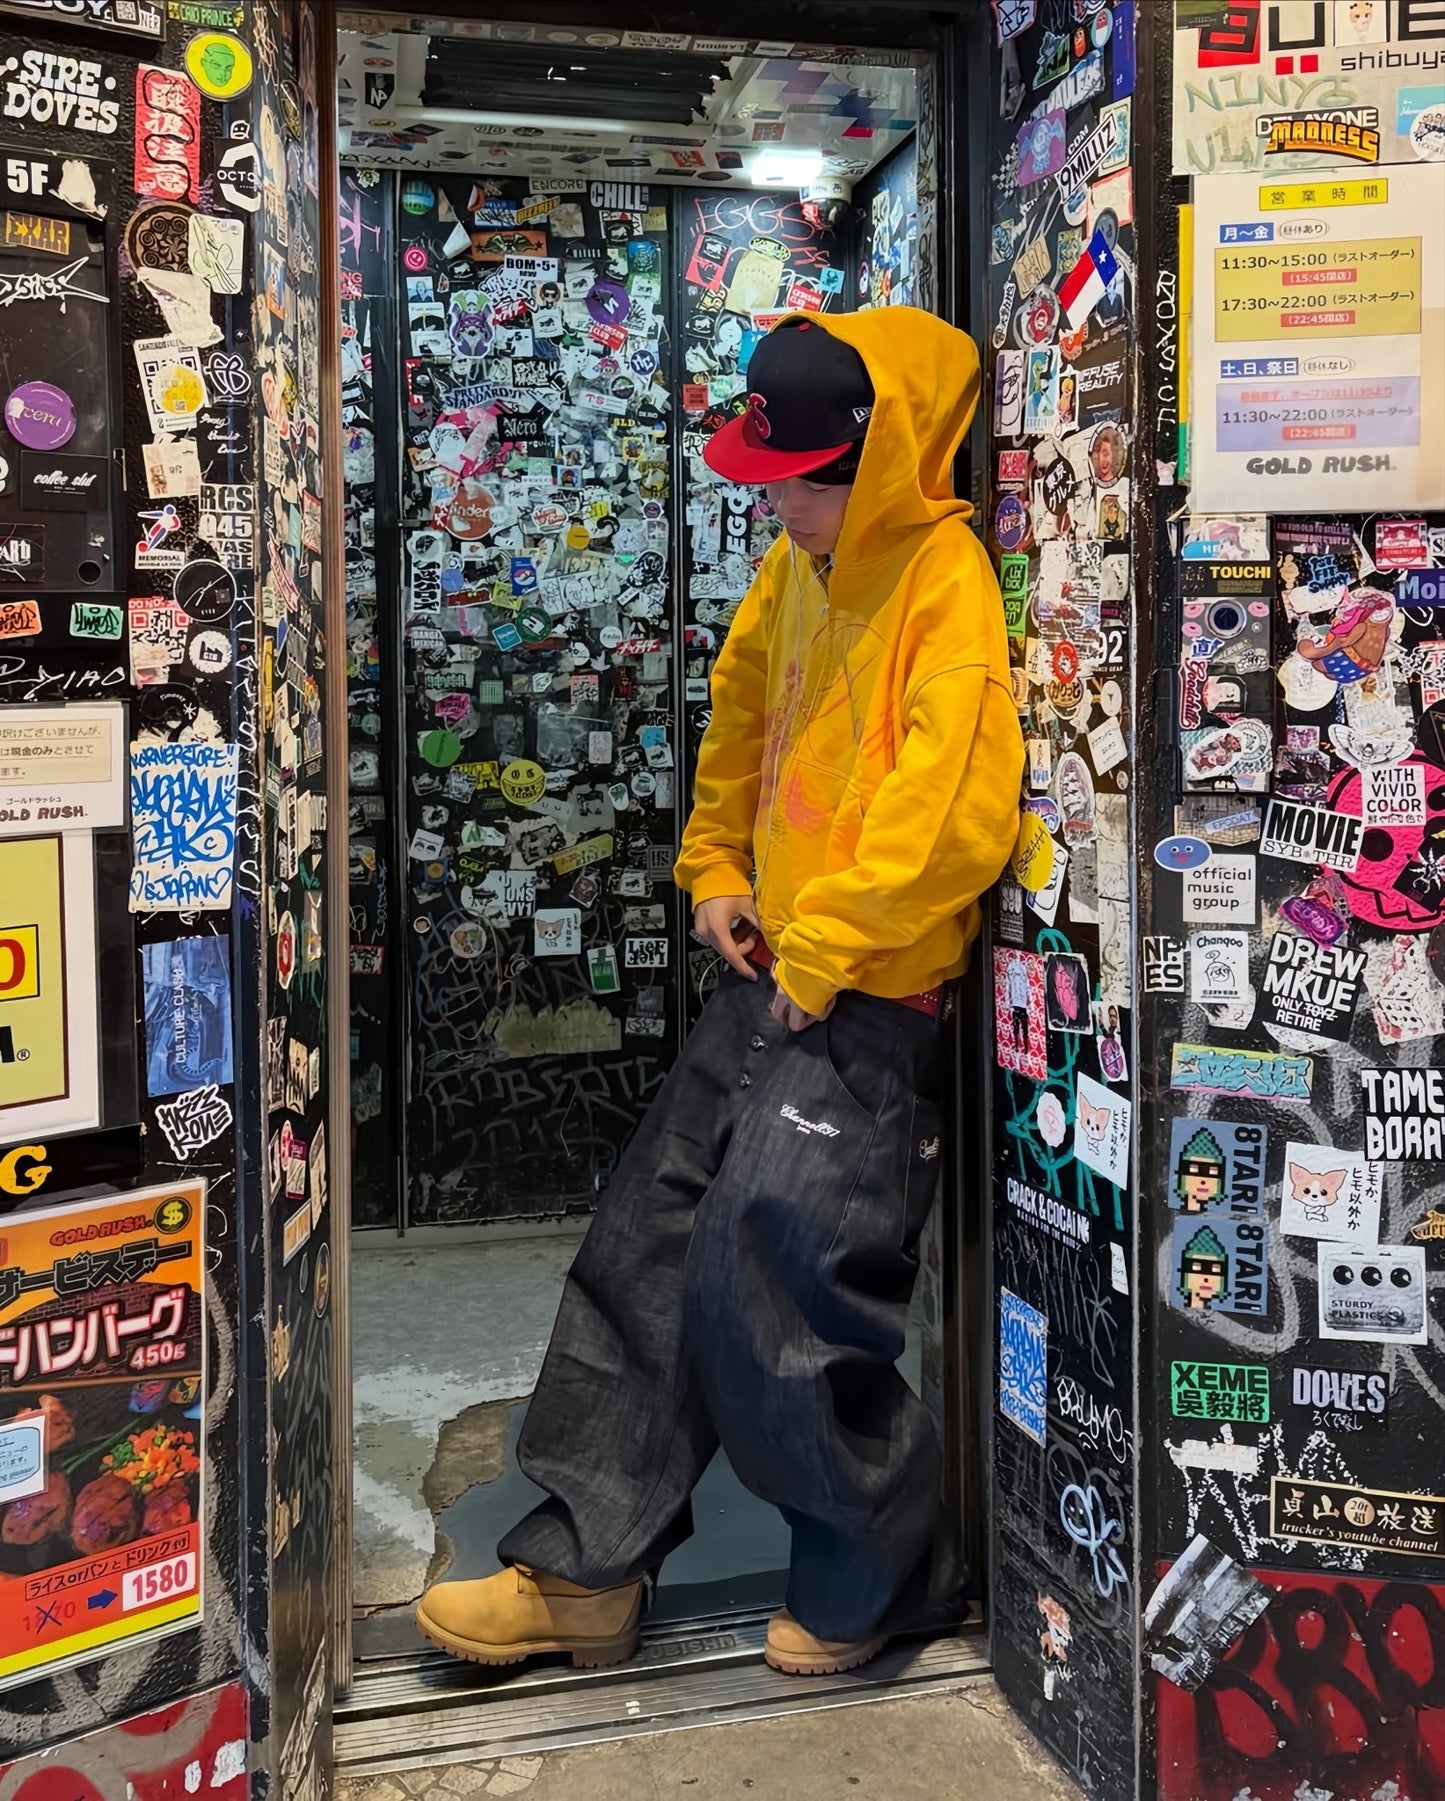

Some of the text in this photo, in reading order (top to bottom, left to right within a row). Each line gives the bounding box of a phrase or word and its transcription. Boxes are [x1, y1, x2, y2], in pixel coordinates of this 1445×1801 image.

[19, 50, 101, 97] SIRE
[4, 82, 120, 134] DOVES
[1266, 121, 1378, 161] MADNESS
[1059, 122, 1116, 197] 9MILLIZ
[7, 159, 49, 195] 5F
[532, 180, 585, 190] ENCORE
[590, 182, 646, 210] CHILL
[1271, 184, 1378, 205] 営業時間
[1222, 253, 1327, 270] 11:30~15:00
[1222, 294, 1327, 311] 17:30~22:00
[1223, 408, 1327, 424] 11:30~22:00
[1246, 456, 1312, 475] GOLD
[33, 470, 69, 486] coffee
[1372, 769, 1414, 781] WITH
[1372, 784, 1416, 798] VIVID
[1367, 799, 1421, 813] COLOR
[1267, 804, 1361, 858] MOVIE
[1193, 867, 1252, 880] official
[1188, 883, 1234, 894] music
[1193, 897, 1240, 911] group
[1264, 963, 1354, 1012] MKUE
[1272, 996, 1303, 1012] ONLY
[1275, 1009, 1322, 1032] RETIRE
[175, 1010, 186, 1064] CULTURE
[1362, 1070, 1445, 1114] TAME
[1007, 1177, 1037, 1216] CRACK
[1039, 1193, 1046, 1220] &
[50, 1225, 99, 1247] GOLD
[1331, 1299, 1374, 1309] STURDY
[1332, 1310, 1384, 1321] PLASTICS
[1173, 1363, 1268, 1394] XEME
[1293, 1367, 1386, 1413] DOVES
[1281, 1522, 1438, 1552] trucker's youtube channel
[132, 1564, 188, 1602] 1580
